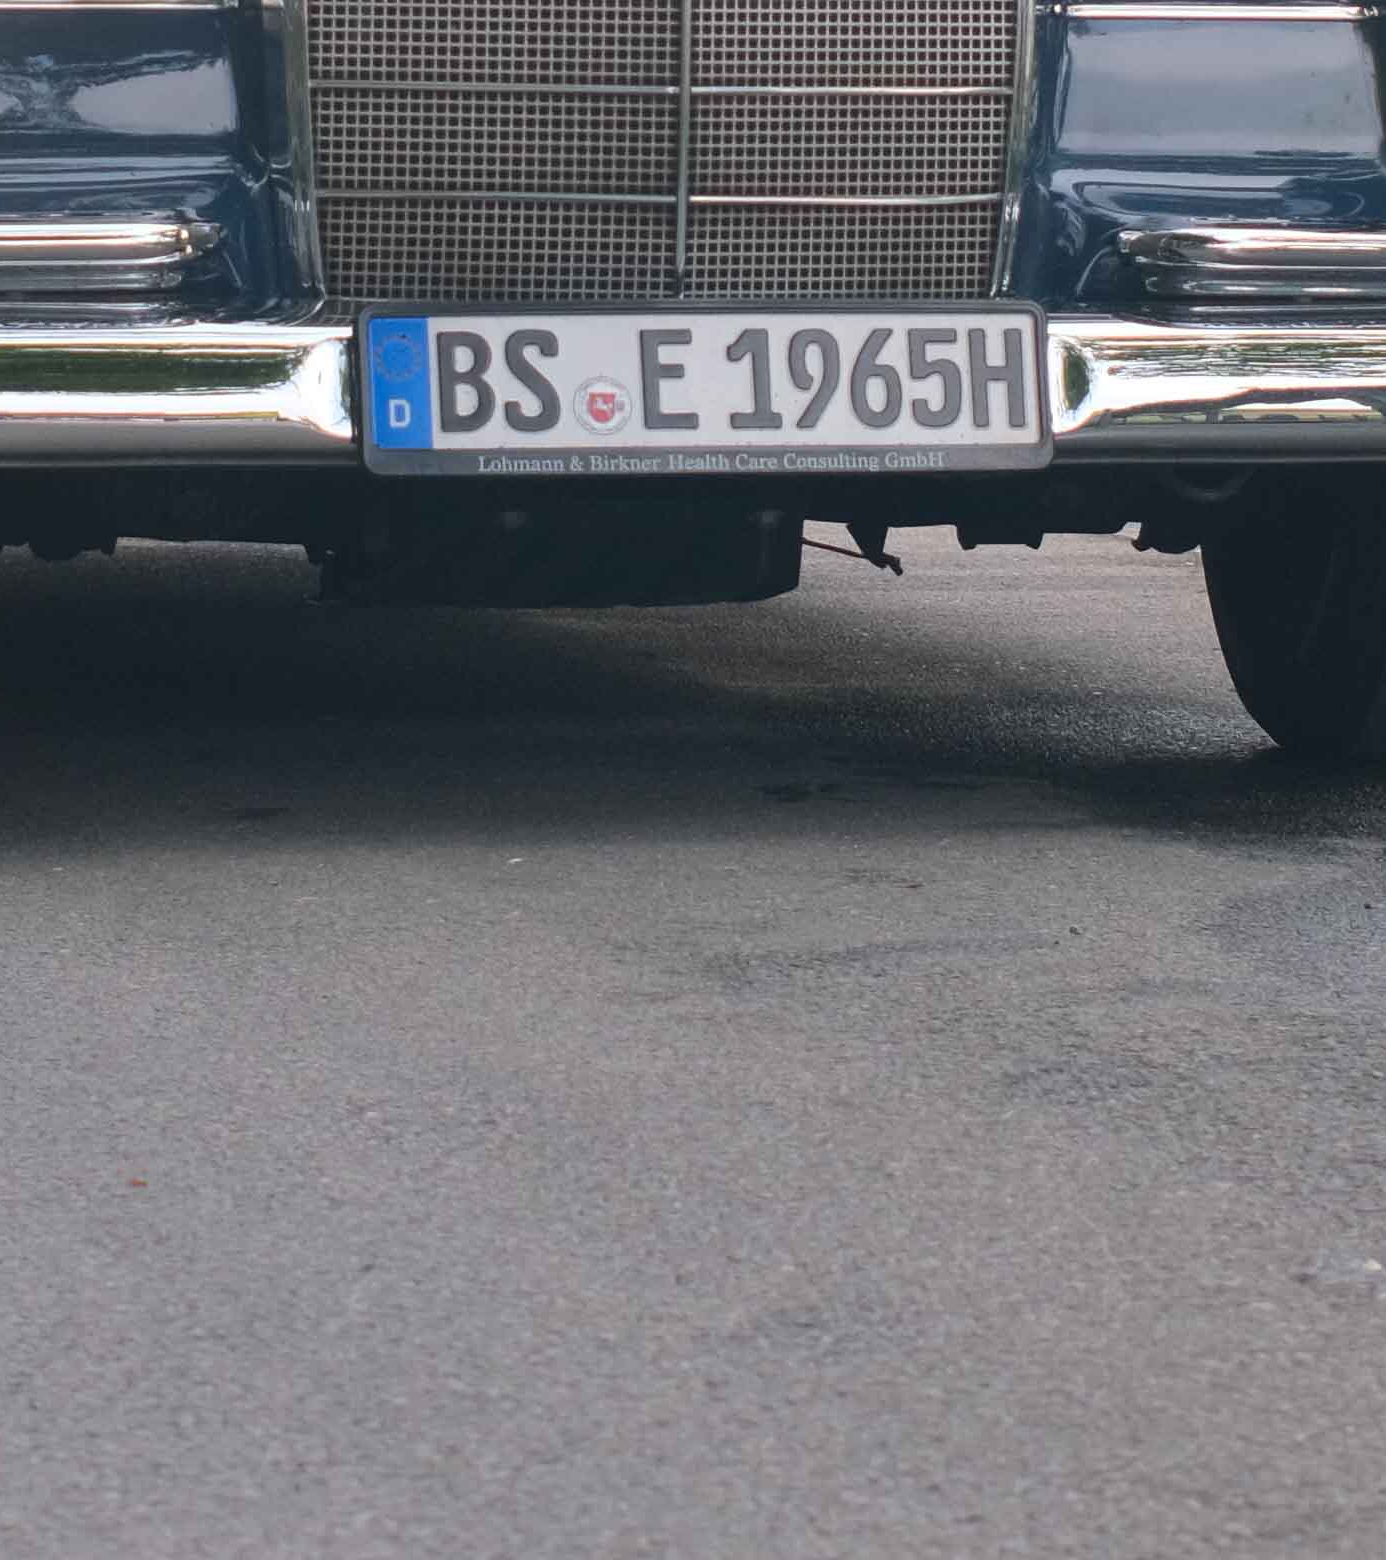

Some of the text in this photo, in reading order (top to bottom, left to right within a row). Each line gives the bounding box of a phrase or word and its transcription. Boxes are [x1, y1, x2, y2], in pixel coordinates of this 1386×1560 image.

[436, 329, 561, 433] BS
[388, 398, 411, 428] D
[477, 451, 945, 473] Lohmann & Birkner Health Care Consulting GmbH
